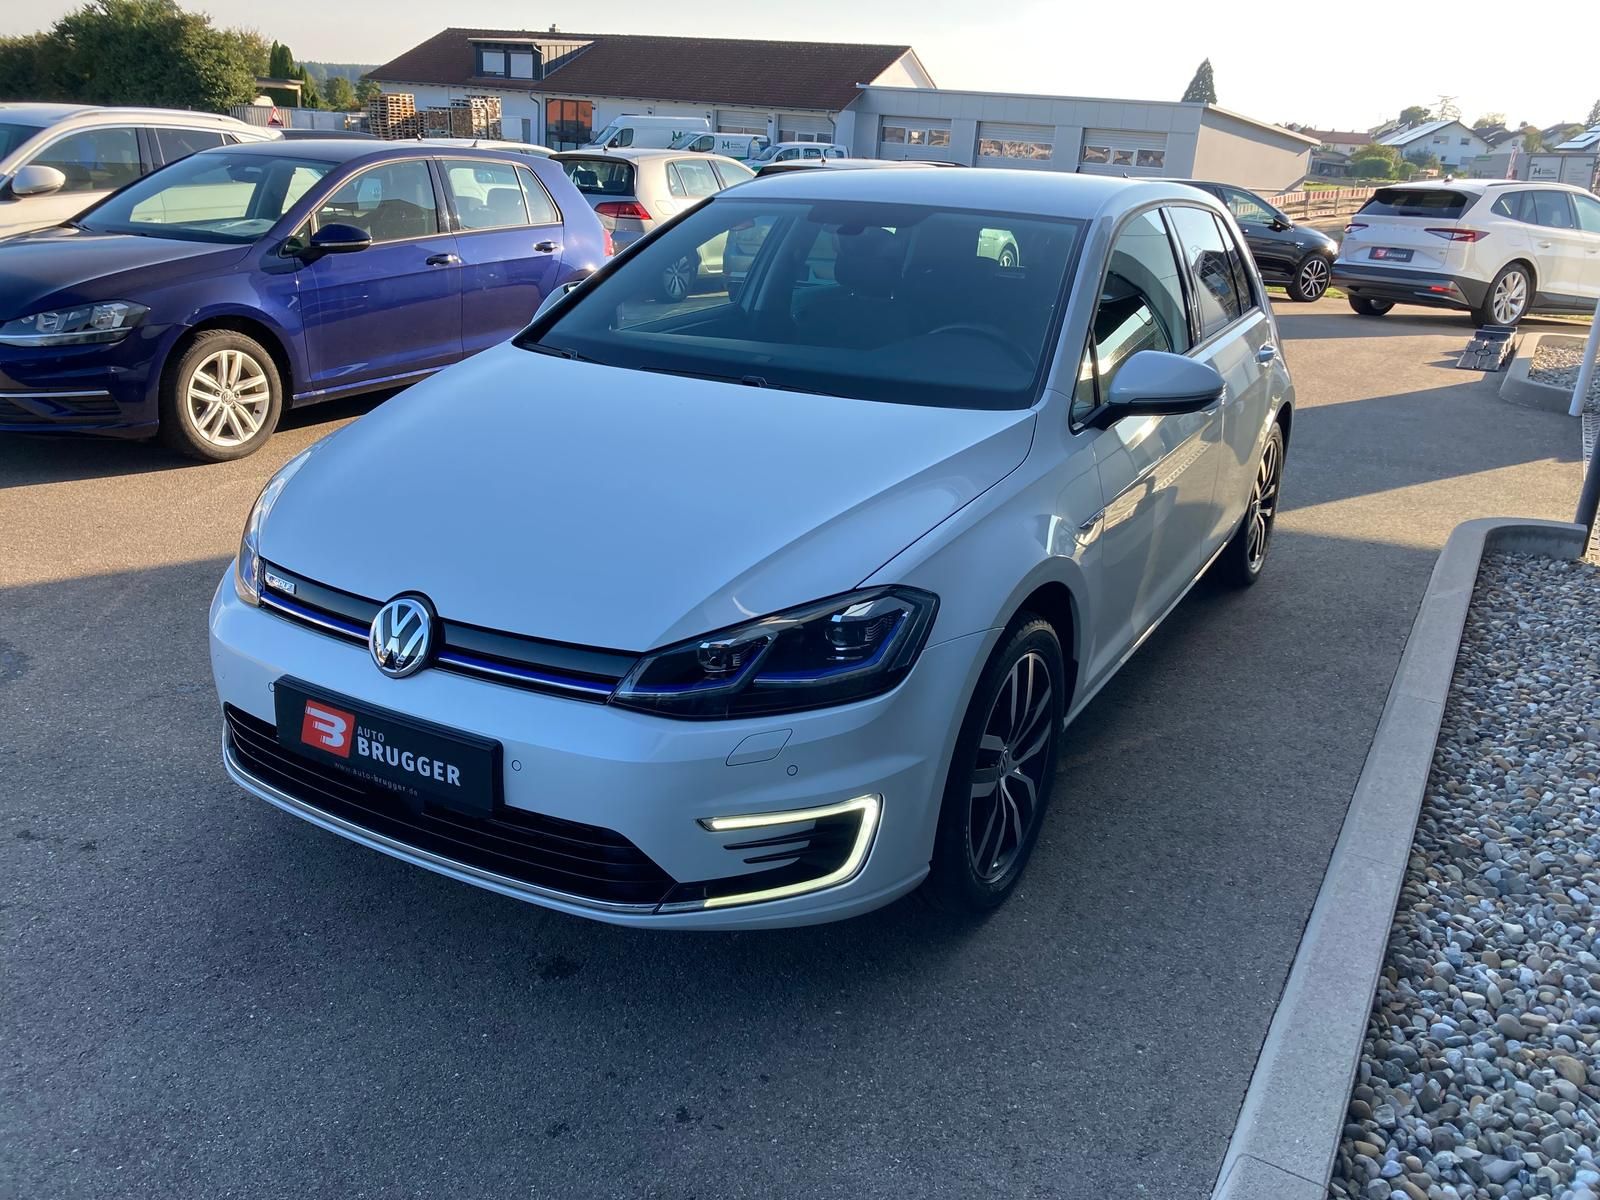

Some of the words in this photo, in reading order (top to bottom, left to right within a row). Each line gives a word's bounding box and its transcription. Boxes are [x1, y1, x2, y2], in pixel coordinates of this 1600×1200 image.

[369, 599, 430, 673] VW
[357, 725, 386, 743] AUTO
[357, 736, 462, 787] BRUGGER
